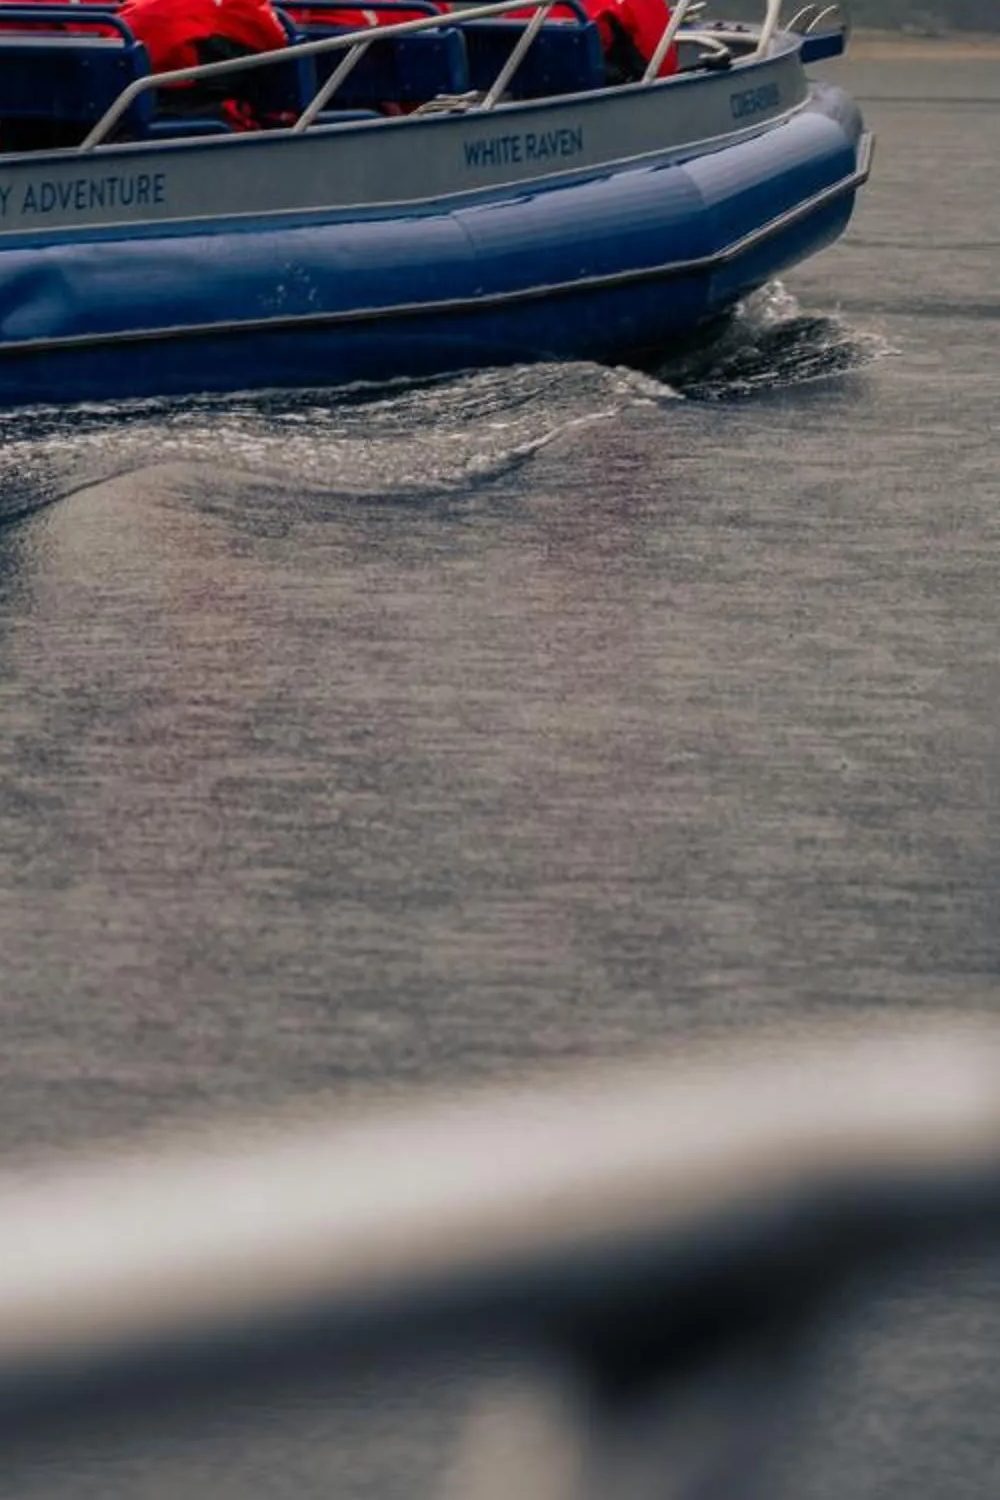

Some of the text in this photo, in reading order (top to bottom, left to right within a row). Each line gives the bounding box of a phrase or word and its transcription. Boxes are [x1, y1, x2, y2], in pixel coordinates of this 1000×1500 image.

[463, 126, 583, 167] WHITE RAVEN
[21, 173, 167, 214] ADVENTURE
